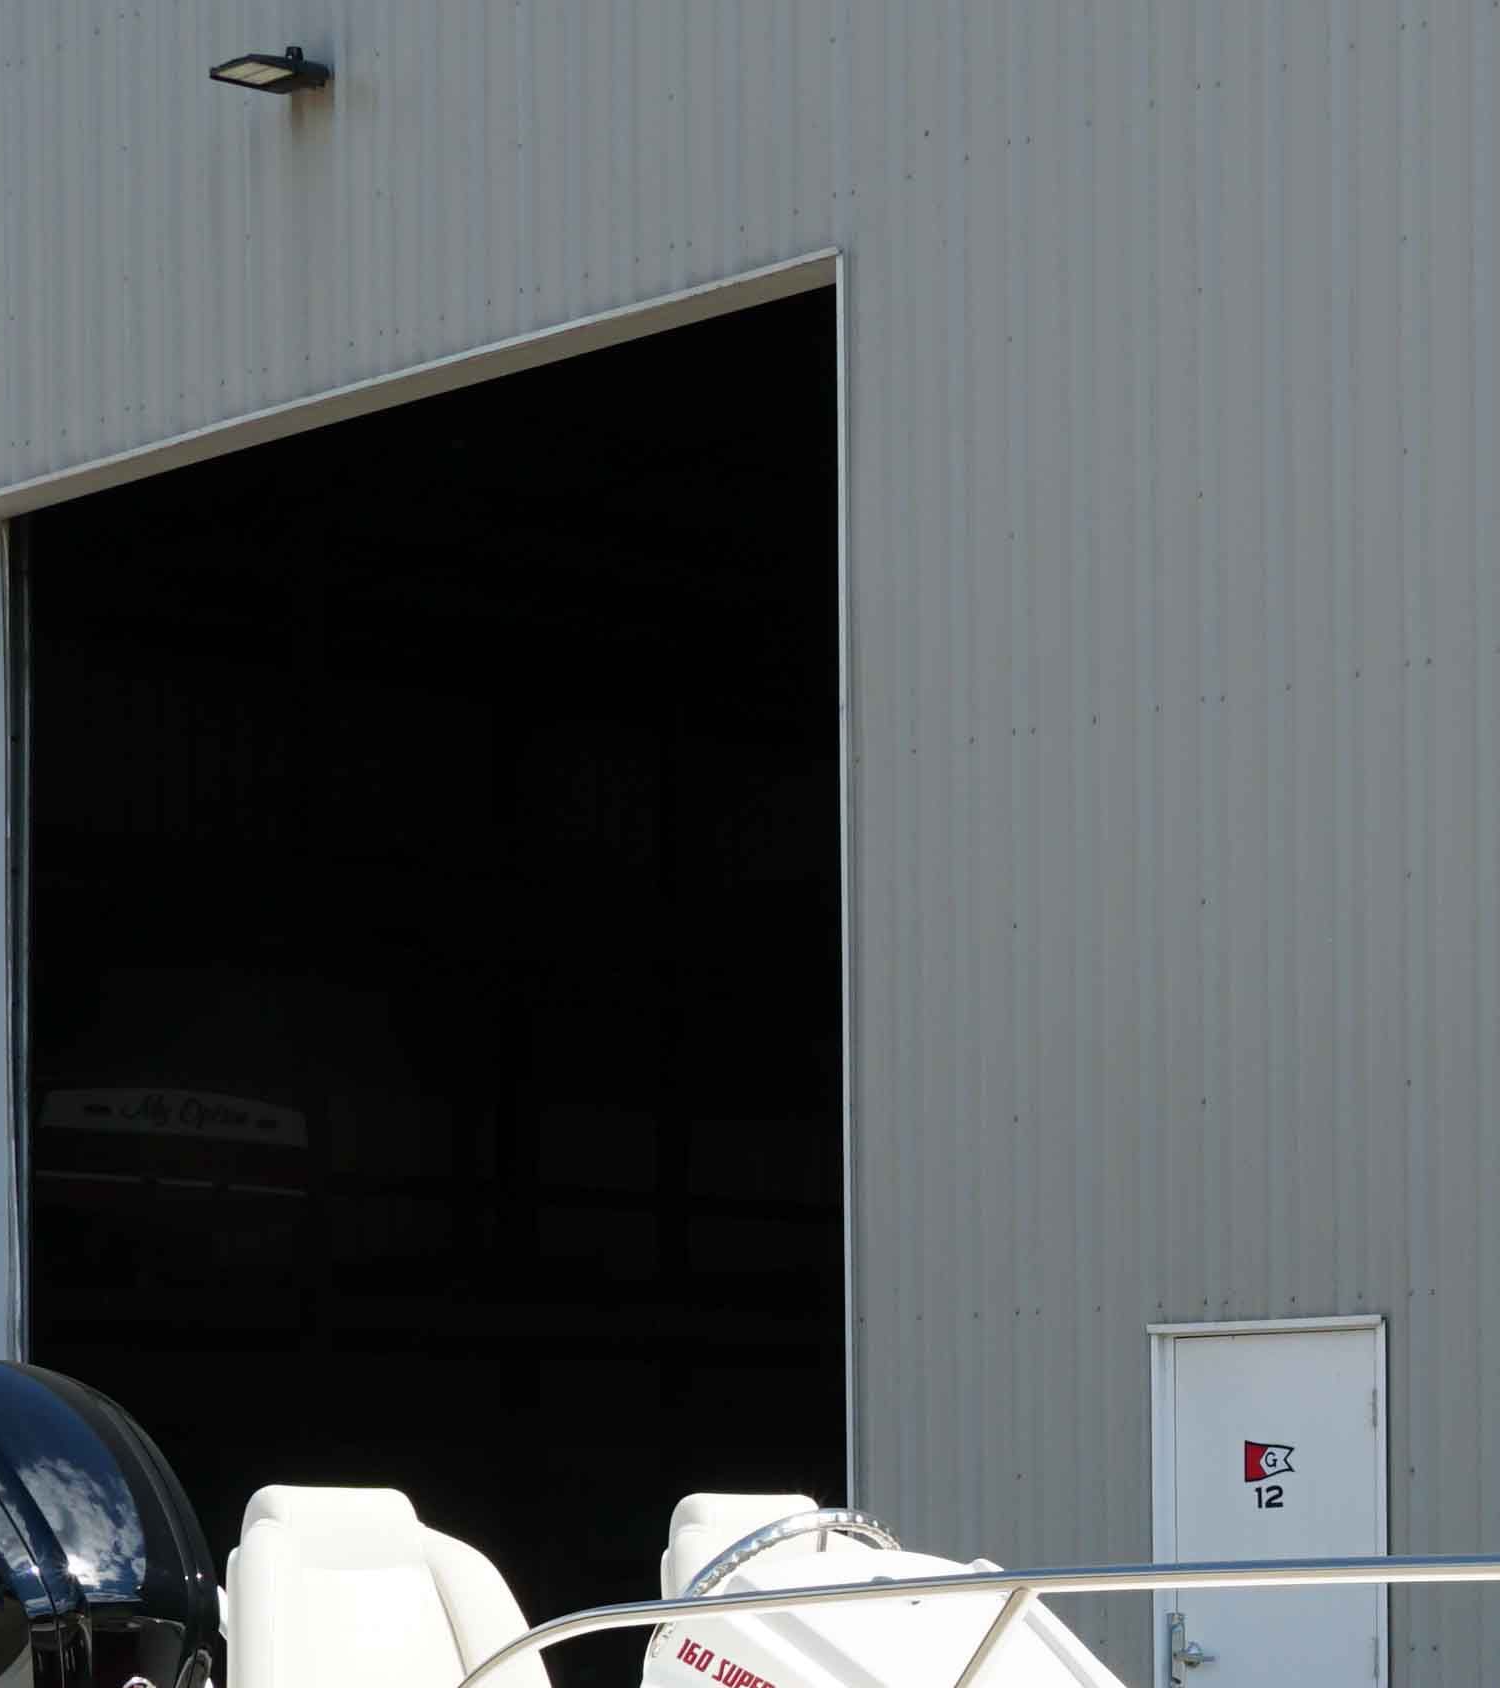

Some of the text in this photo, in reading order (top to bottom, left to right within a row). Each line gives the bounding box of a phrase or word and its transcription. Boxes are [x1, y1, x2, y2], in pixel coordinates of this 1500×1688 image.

[1264, 1451, 1278, 1468] G
[1254, 1485, 1284, 1509] 12
[676, 1637, 715, 1673] 160
